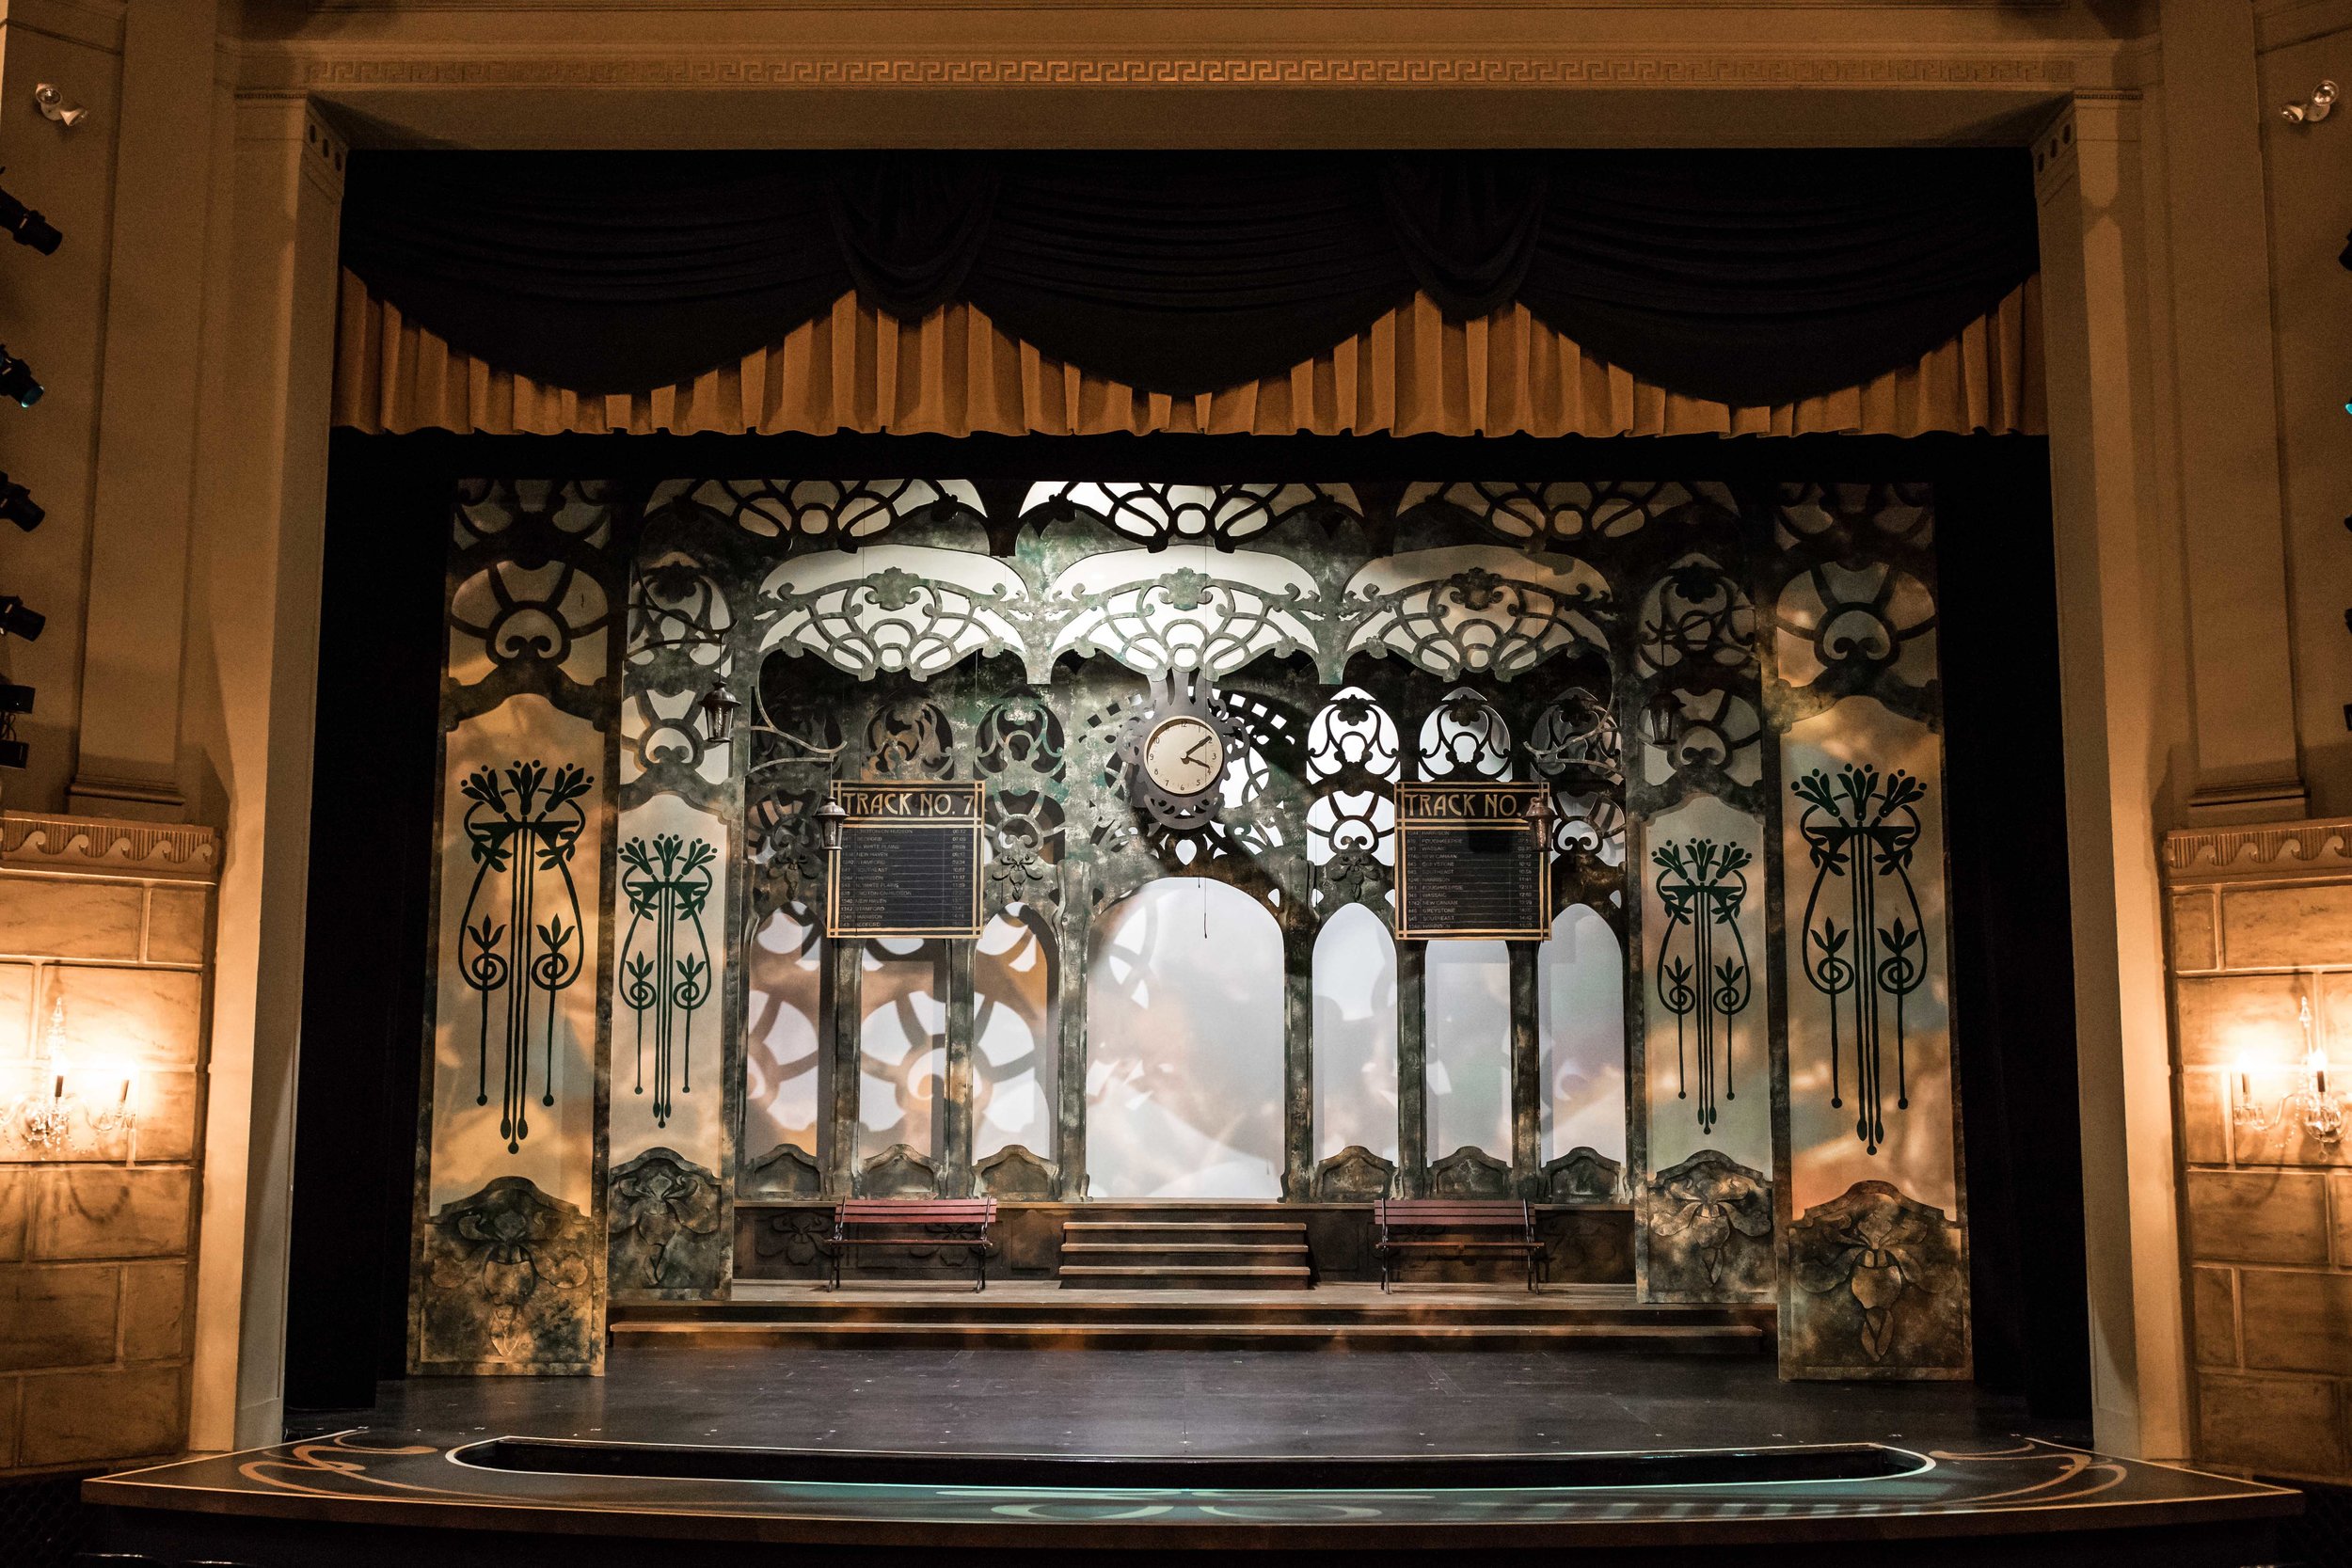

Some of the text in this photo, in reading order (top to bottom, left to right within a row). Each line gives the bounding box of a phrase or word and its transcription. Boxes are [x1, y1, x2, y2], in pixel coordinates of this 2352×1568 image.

[842, 793, 975, 816] TRACK NO. 7
[1405, 794, 1475, 816] TRACK
[1485, 794, 1521, 817] NO.
